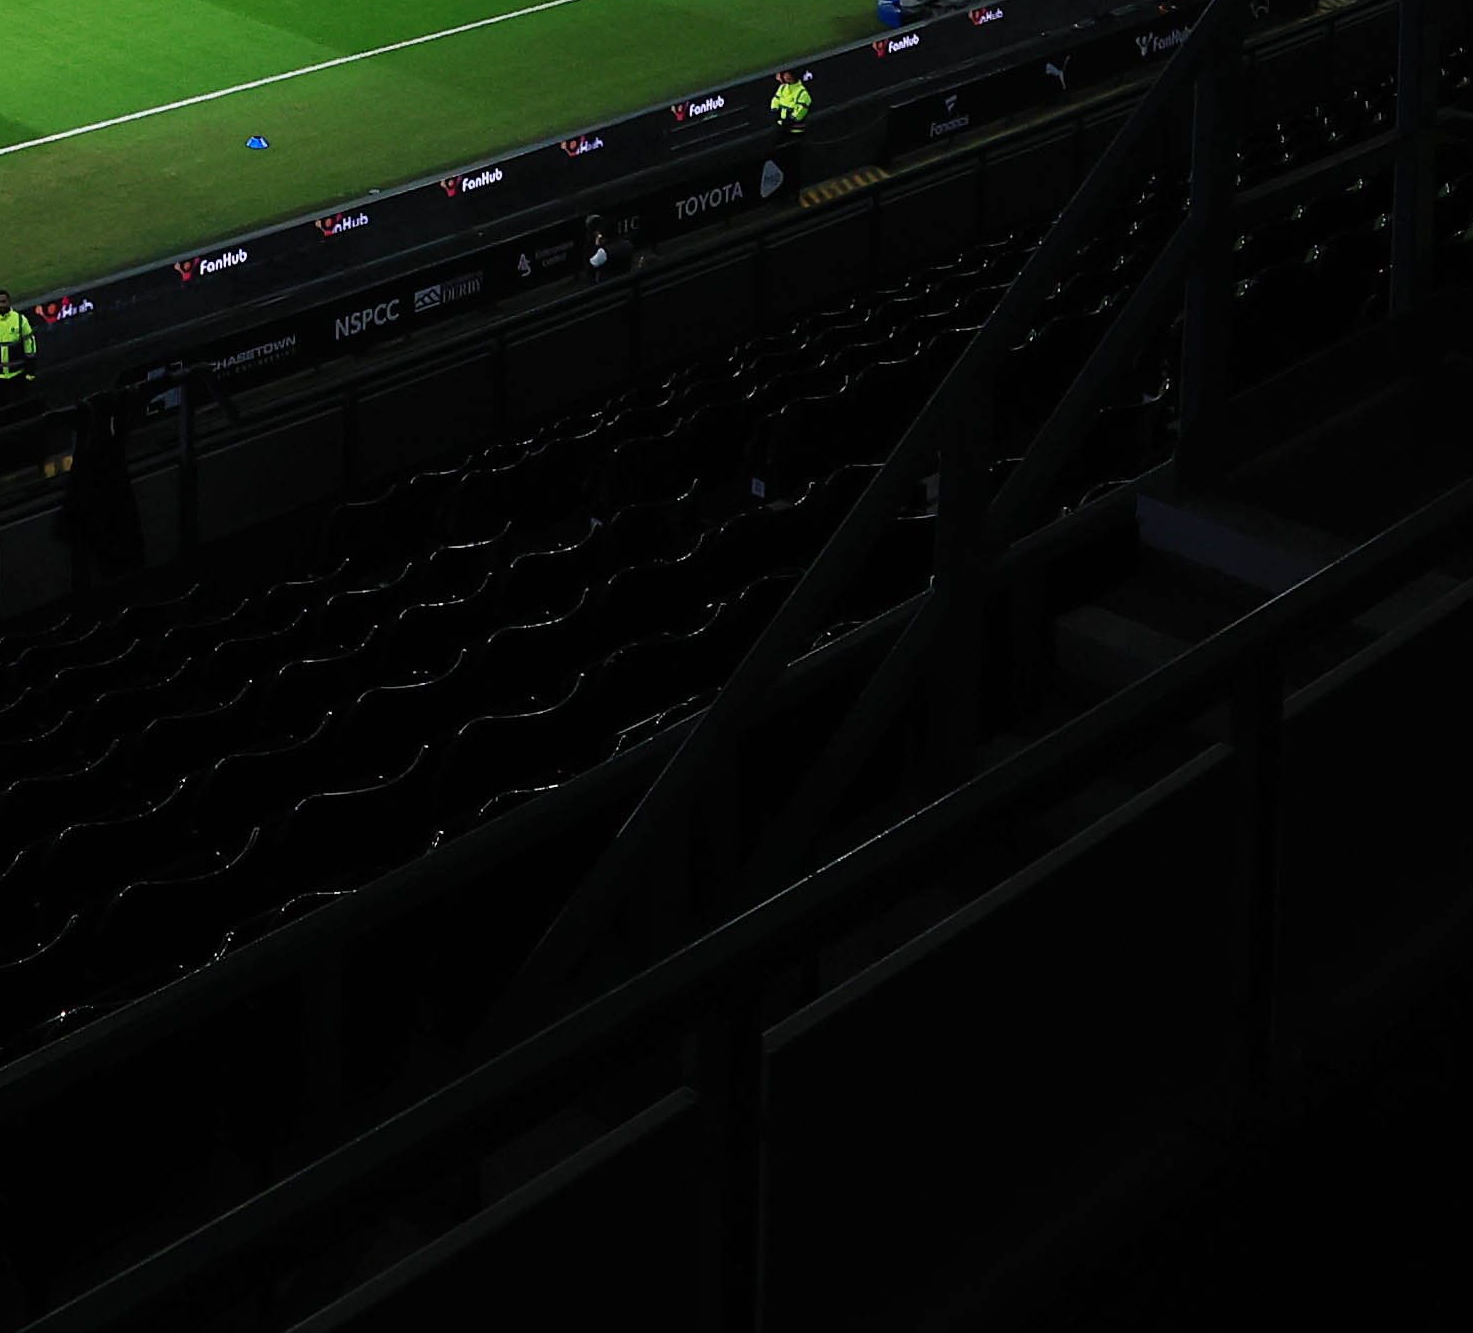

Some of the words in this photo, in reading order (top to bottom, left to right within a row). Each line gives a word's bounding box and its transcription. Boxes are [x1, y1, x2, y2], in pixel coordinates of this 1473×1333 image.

[888, 32, 921, 54] FanHub
[688, 95, 726, 118] FanHub
[462, 167, 504, 194] FanHub
[674, 181, 745, 223] TOYOTA
[332, 213, 371, 237] nHub
[198, 248, 249, 277] FanHub
[334, 298, 401, 343] NSPCC
